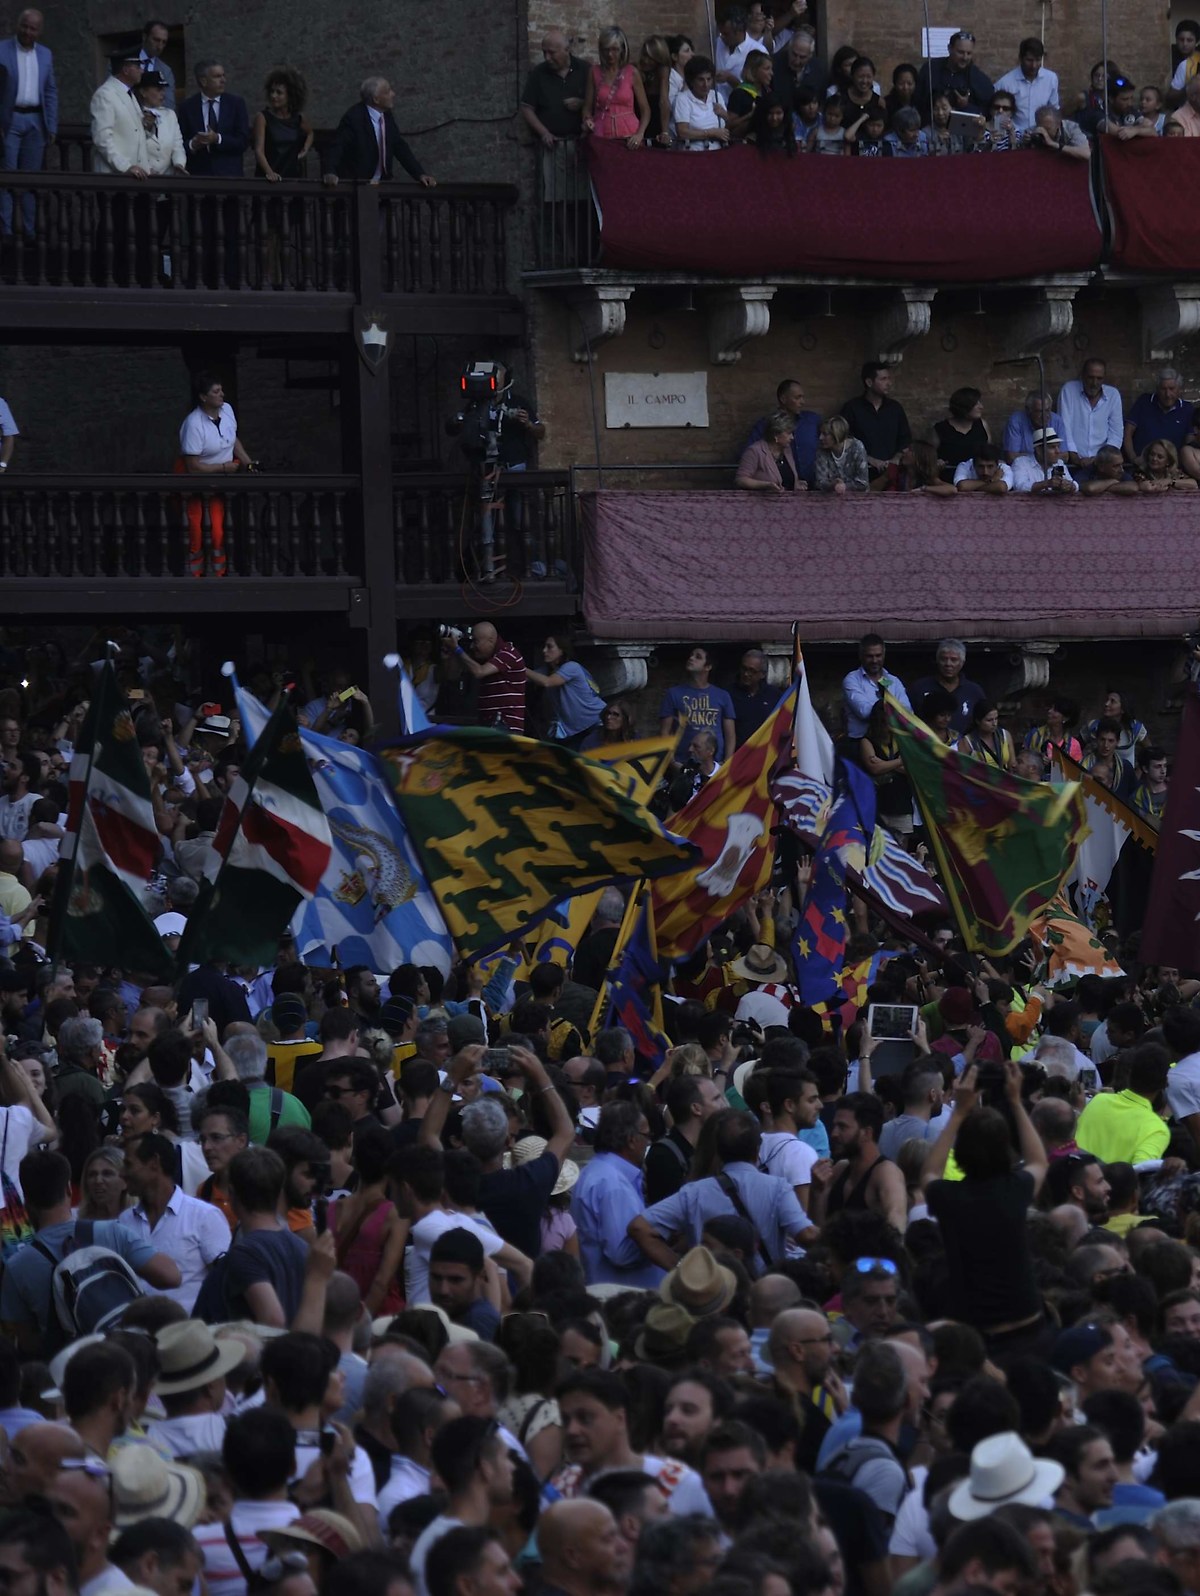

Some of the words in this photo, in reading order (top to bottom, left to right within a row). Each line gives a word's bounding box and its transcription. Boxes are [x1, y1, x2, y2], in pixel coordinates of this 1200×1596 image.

[628, 394, 639, 405] IL
[645, 393, 687, 405] CAMPO
[683, 695, 720, 712] SOUL
